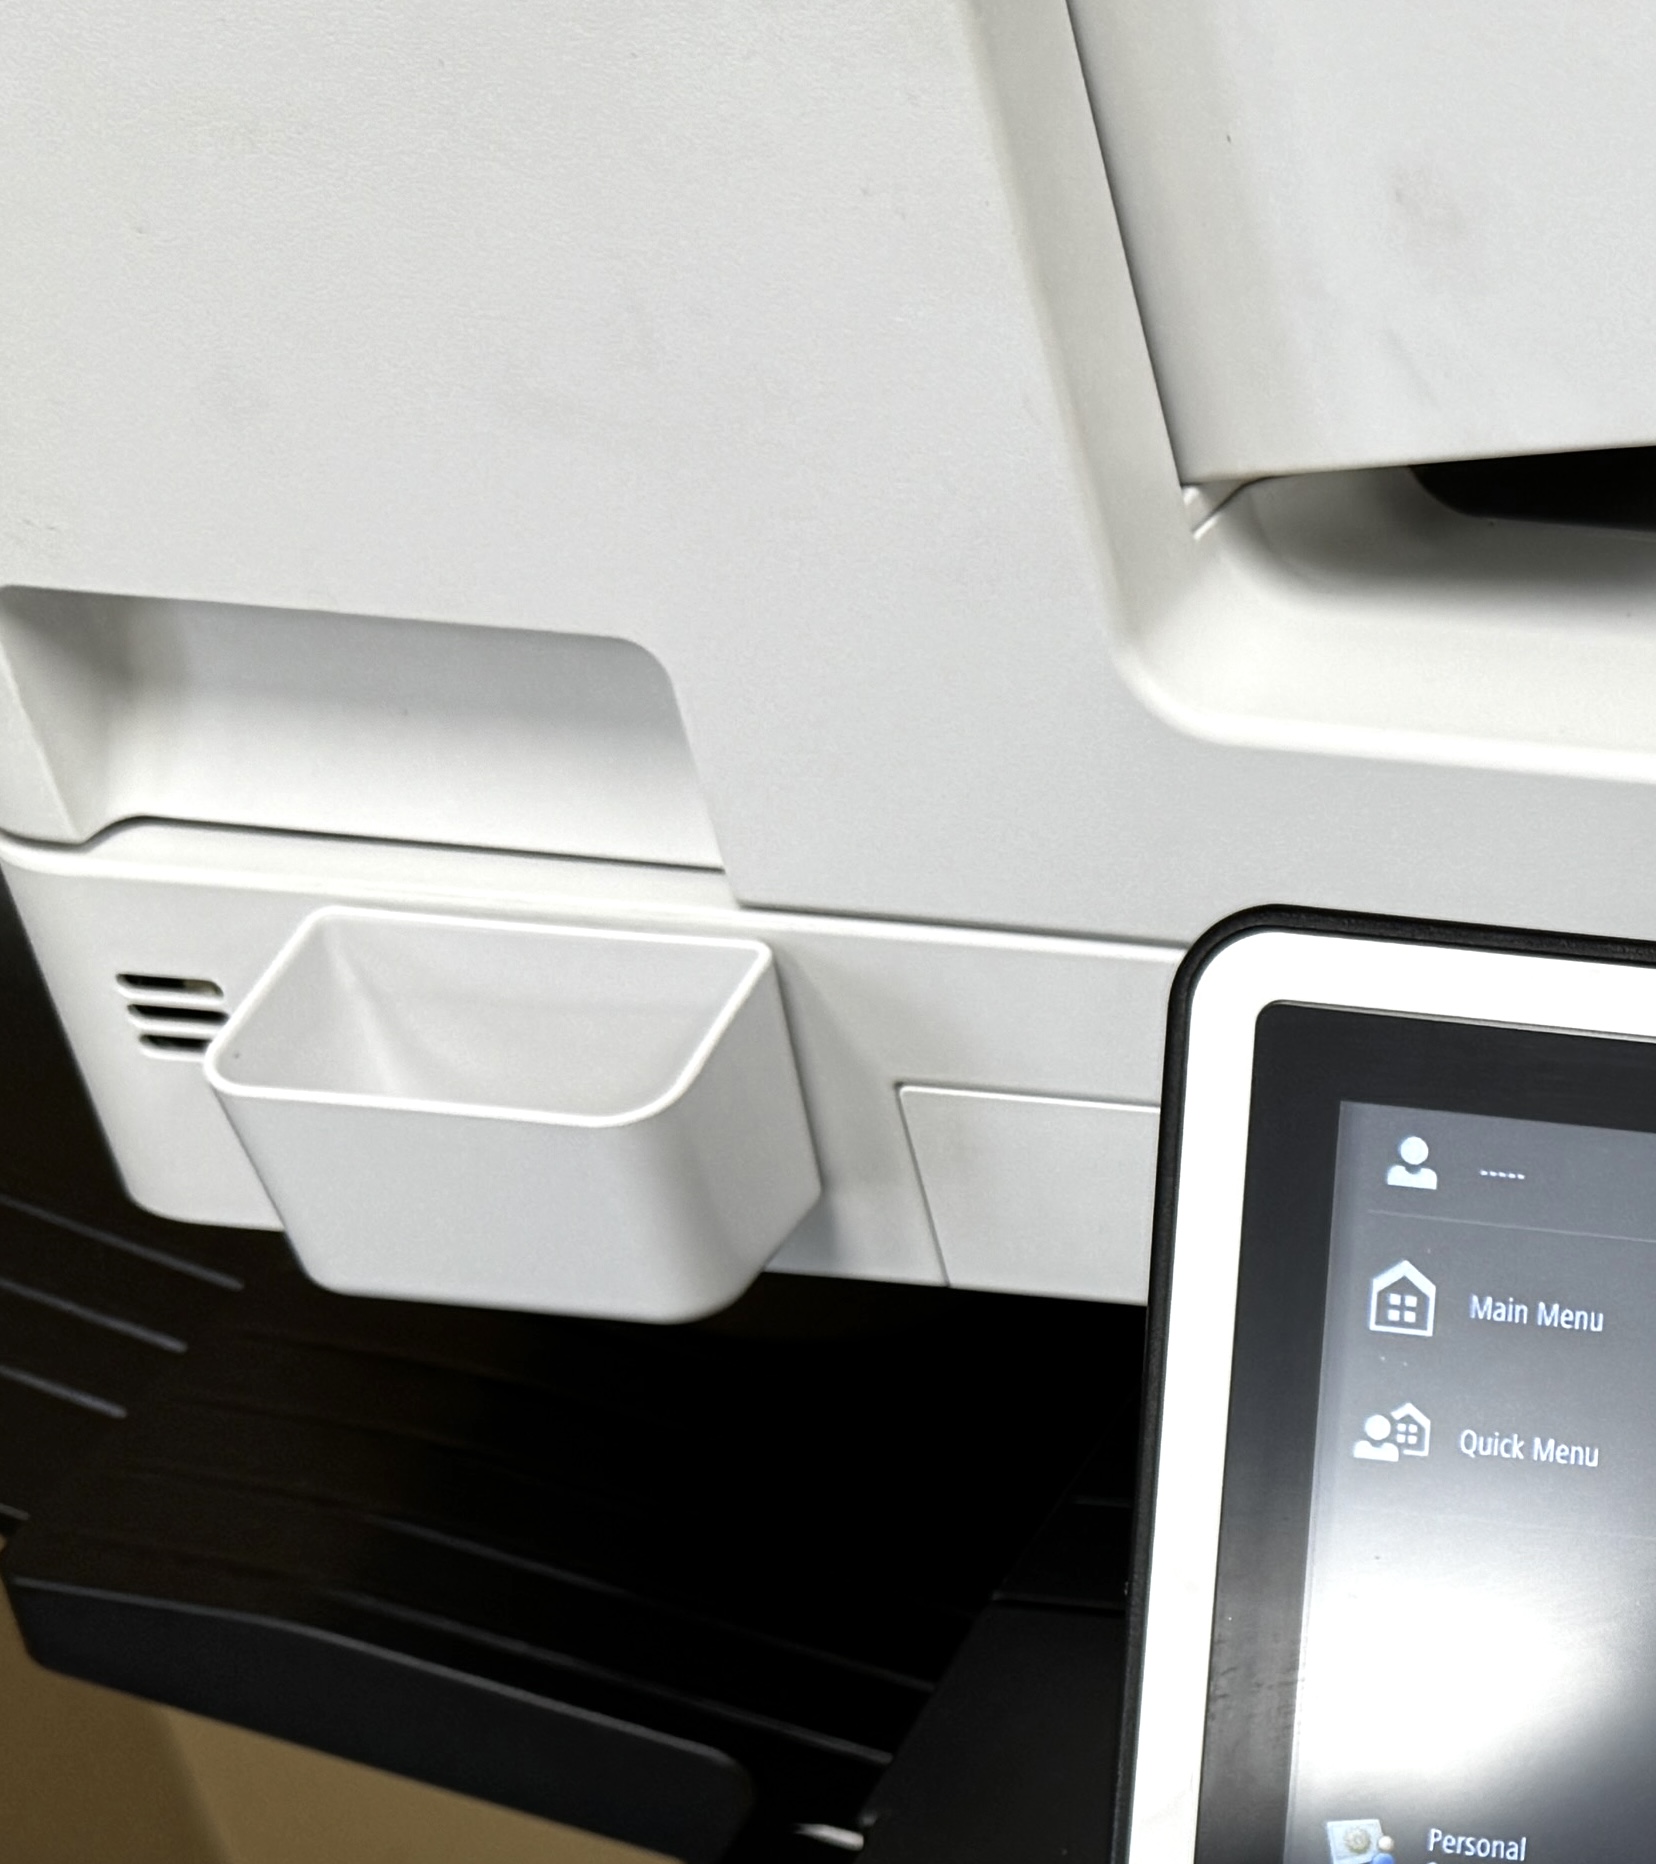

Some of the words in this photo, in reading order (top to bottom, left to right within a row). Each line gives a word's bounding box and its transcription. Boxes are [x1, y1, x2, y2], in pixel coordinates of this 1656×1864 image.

[1468, 1293, 1529, 1325] Main
[1535, 1300, 1604, 1334] Menu
[1458, 1428, 1524, 1463] Quick
[1532, 1436, 1600, 1468] Menu
[1427, 1828, 1527, 1863] Personal
